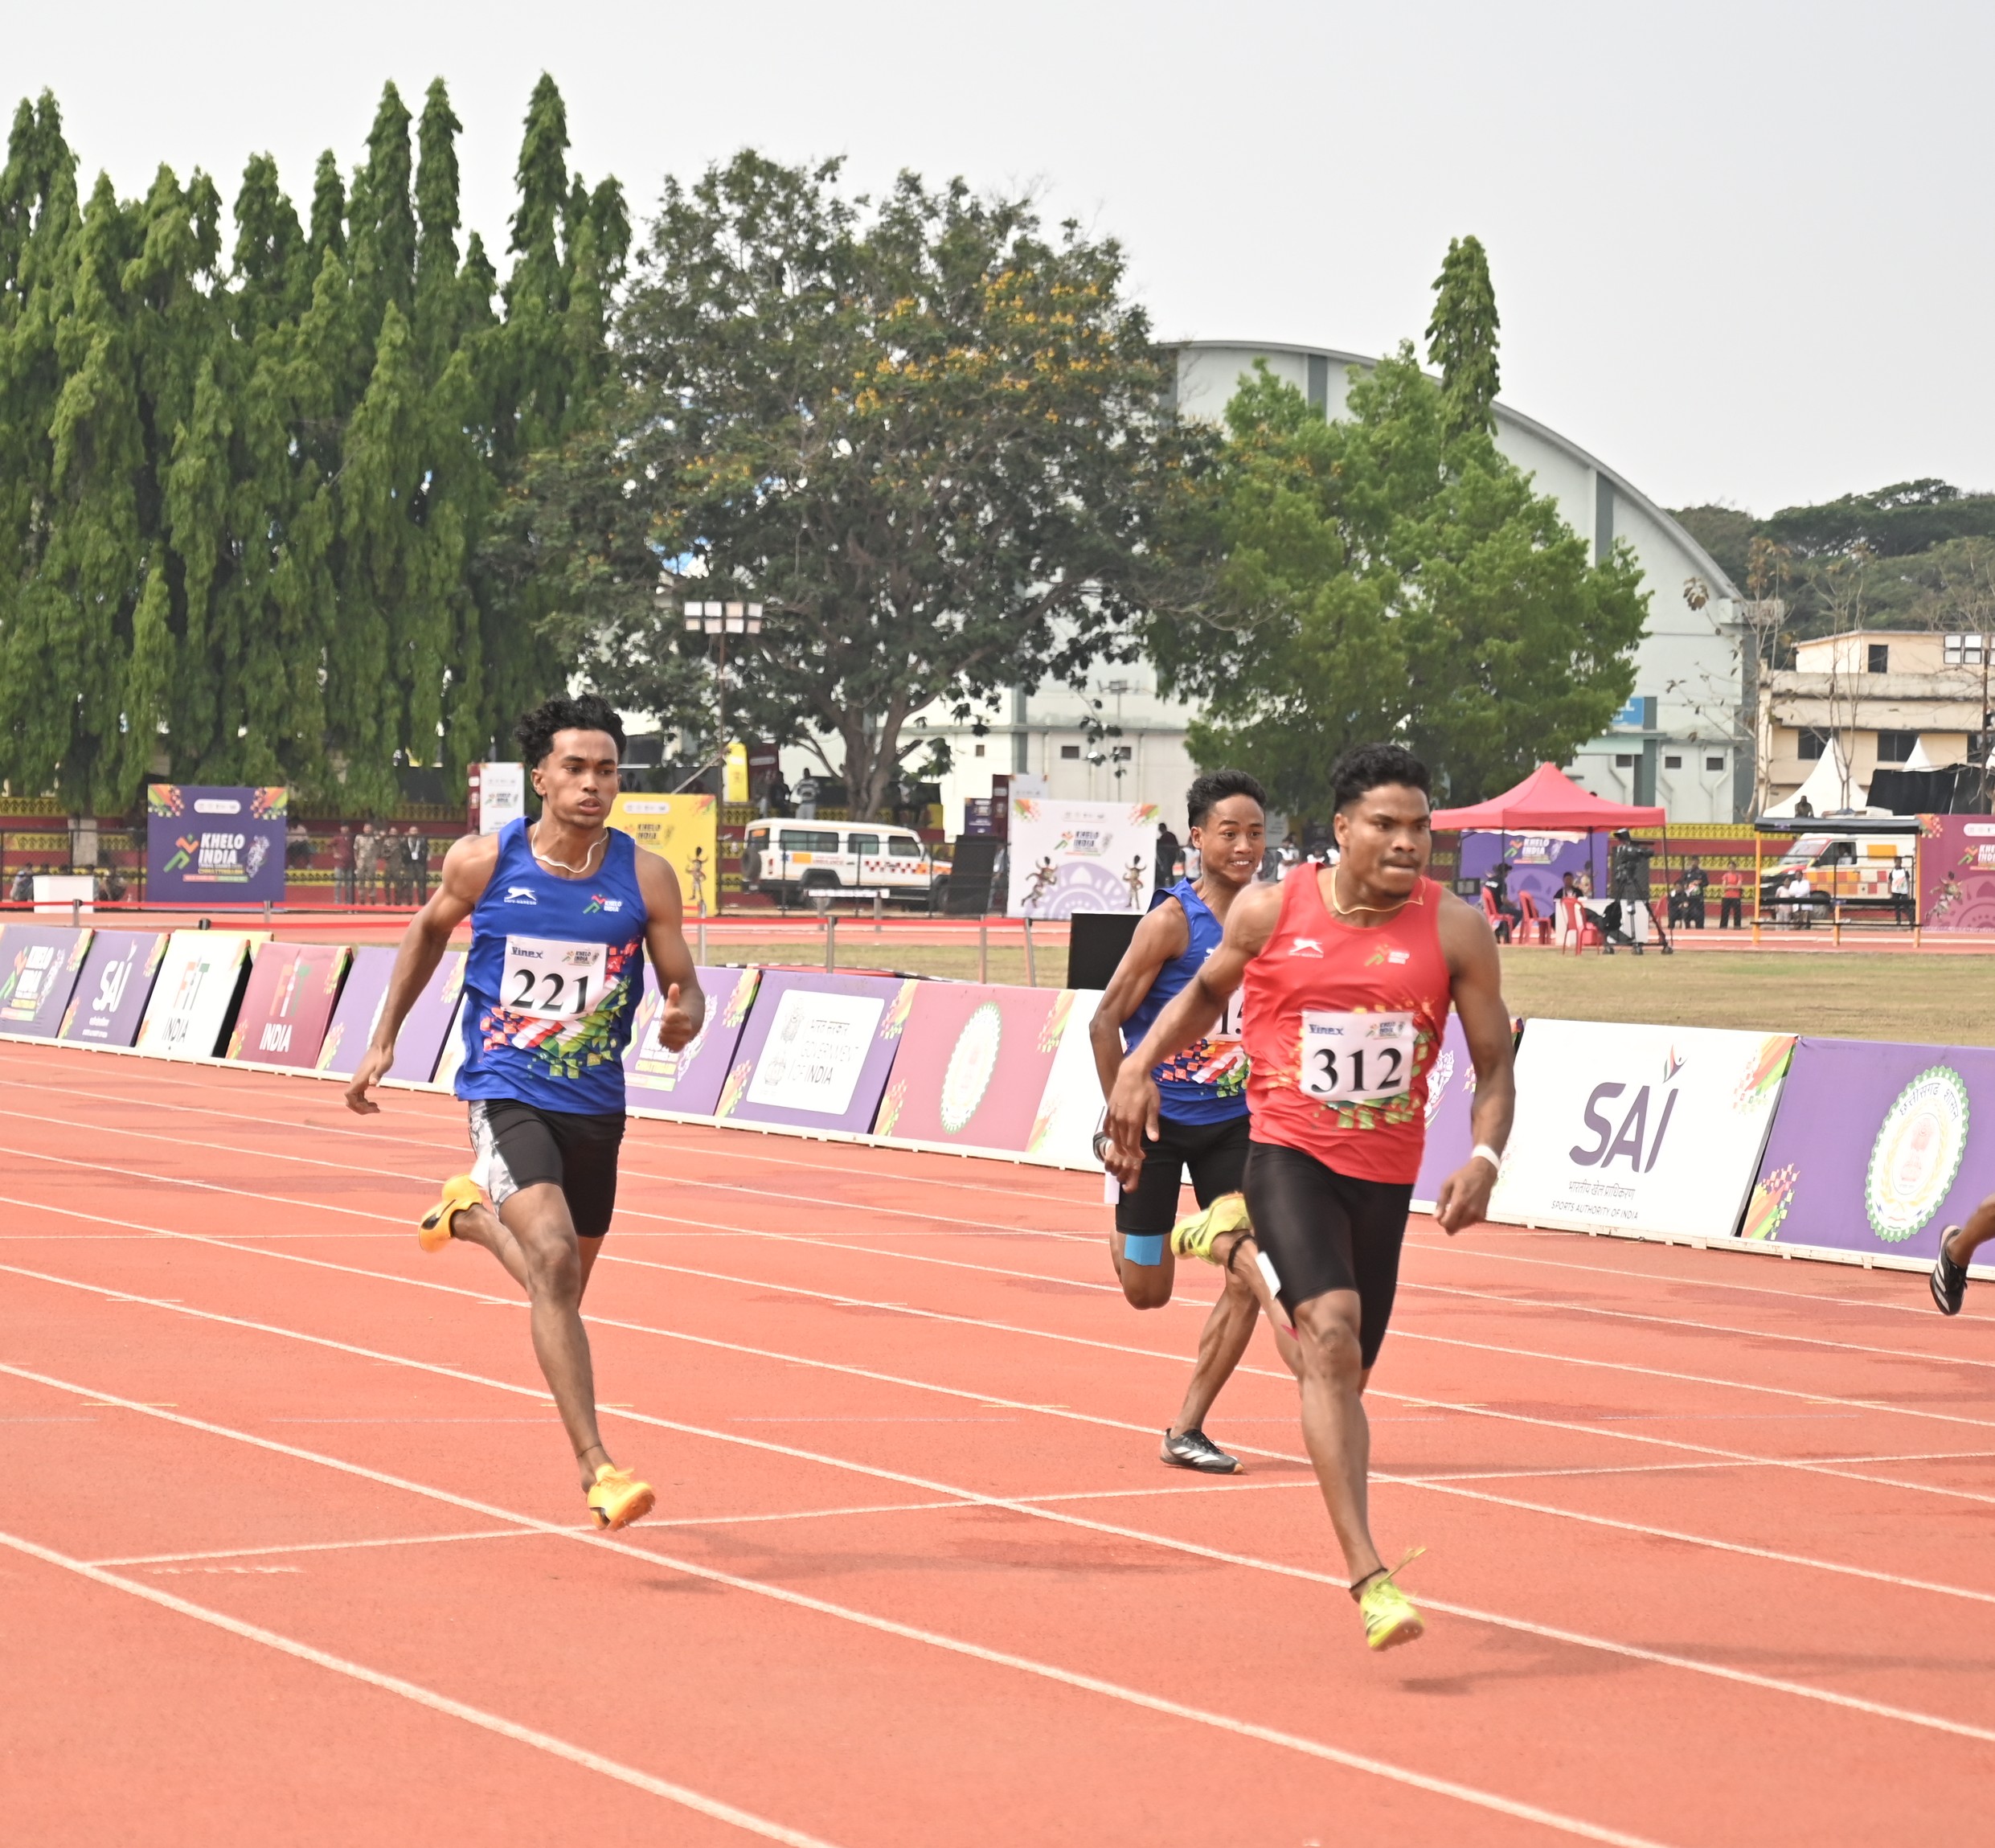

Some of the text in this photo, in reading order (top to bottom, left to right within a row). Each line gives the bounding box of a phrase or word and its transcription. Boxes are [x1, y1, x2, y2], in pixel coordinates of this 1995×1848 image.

[201, 833, 245, 850] KHELO
[198, 850, 237, 864] INDIA
[510, 946, 543, 959] Vinex
[92, 961, 133, 1013] SAI
[510, 969, 589, 1014] 221
[162, 1017, 189, 1043] INDIA
[259, 1023, 293, 1052] INDIA
[1309, 1024, 1344, 1036] Vinex
[805, 1065, 833, 1084] INDIA
[1311, 1048, 1402, 1093] 312
[1569, 1082, 1679, 1173] SAI
[1569, 1178, 1636, 1200] भारतीय खेल प्राधिकरण
[1551, 1200, 1638, 1220] SPORTS AUTHORITY OF INDIA
